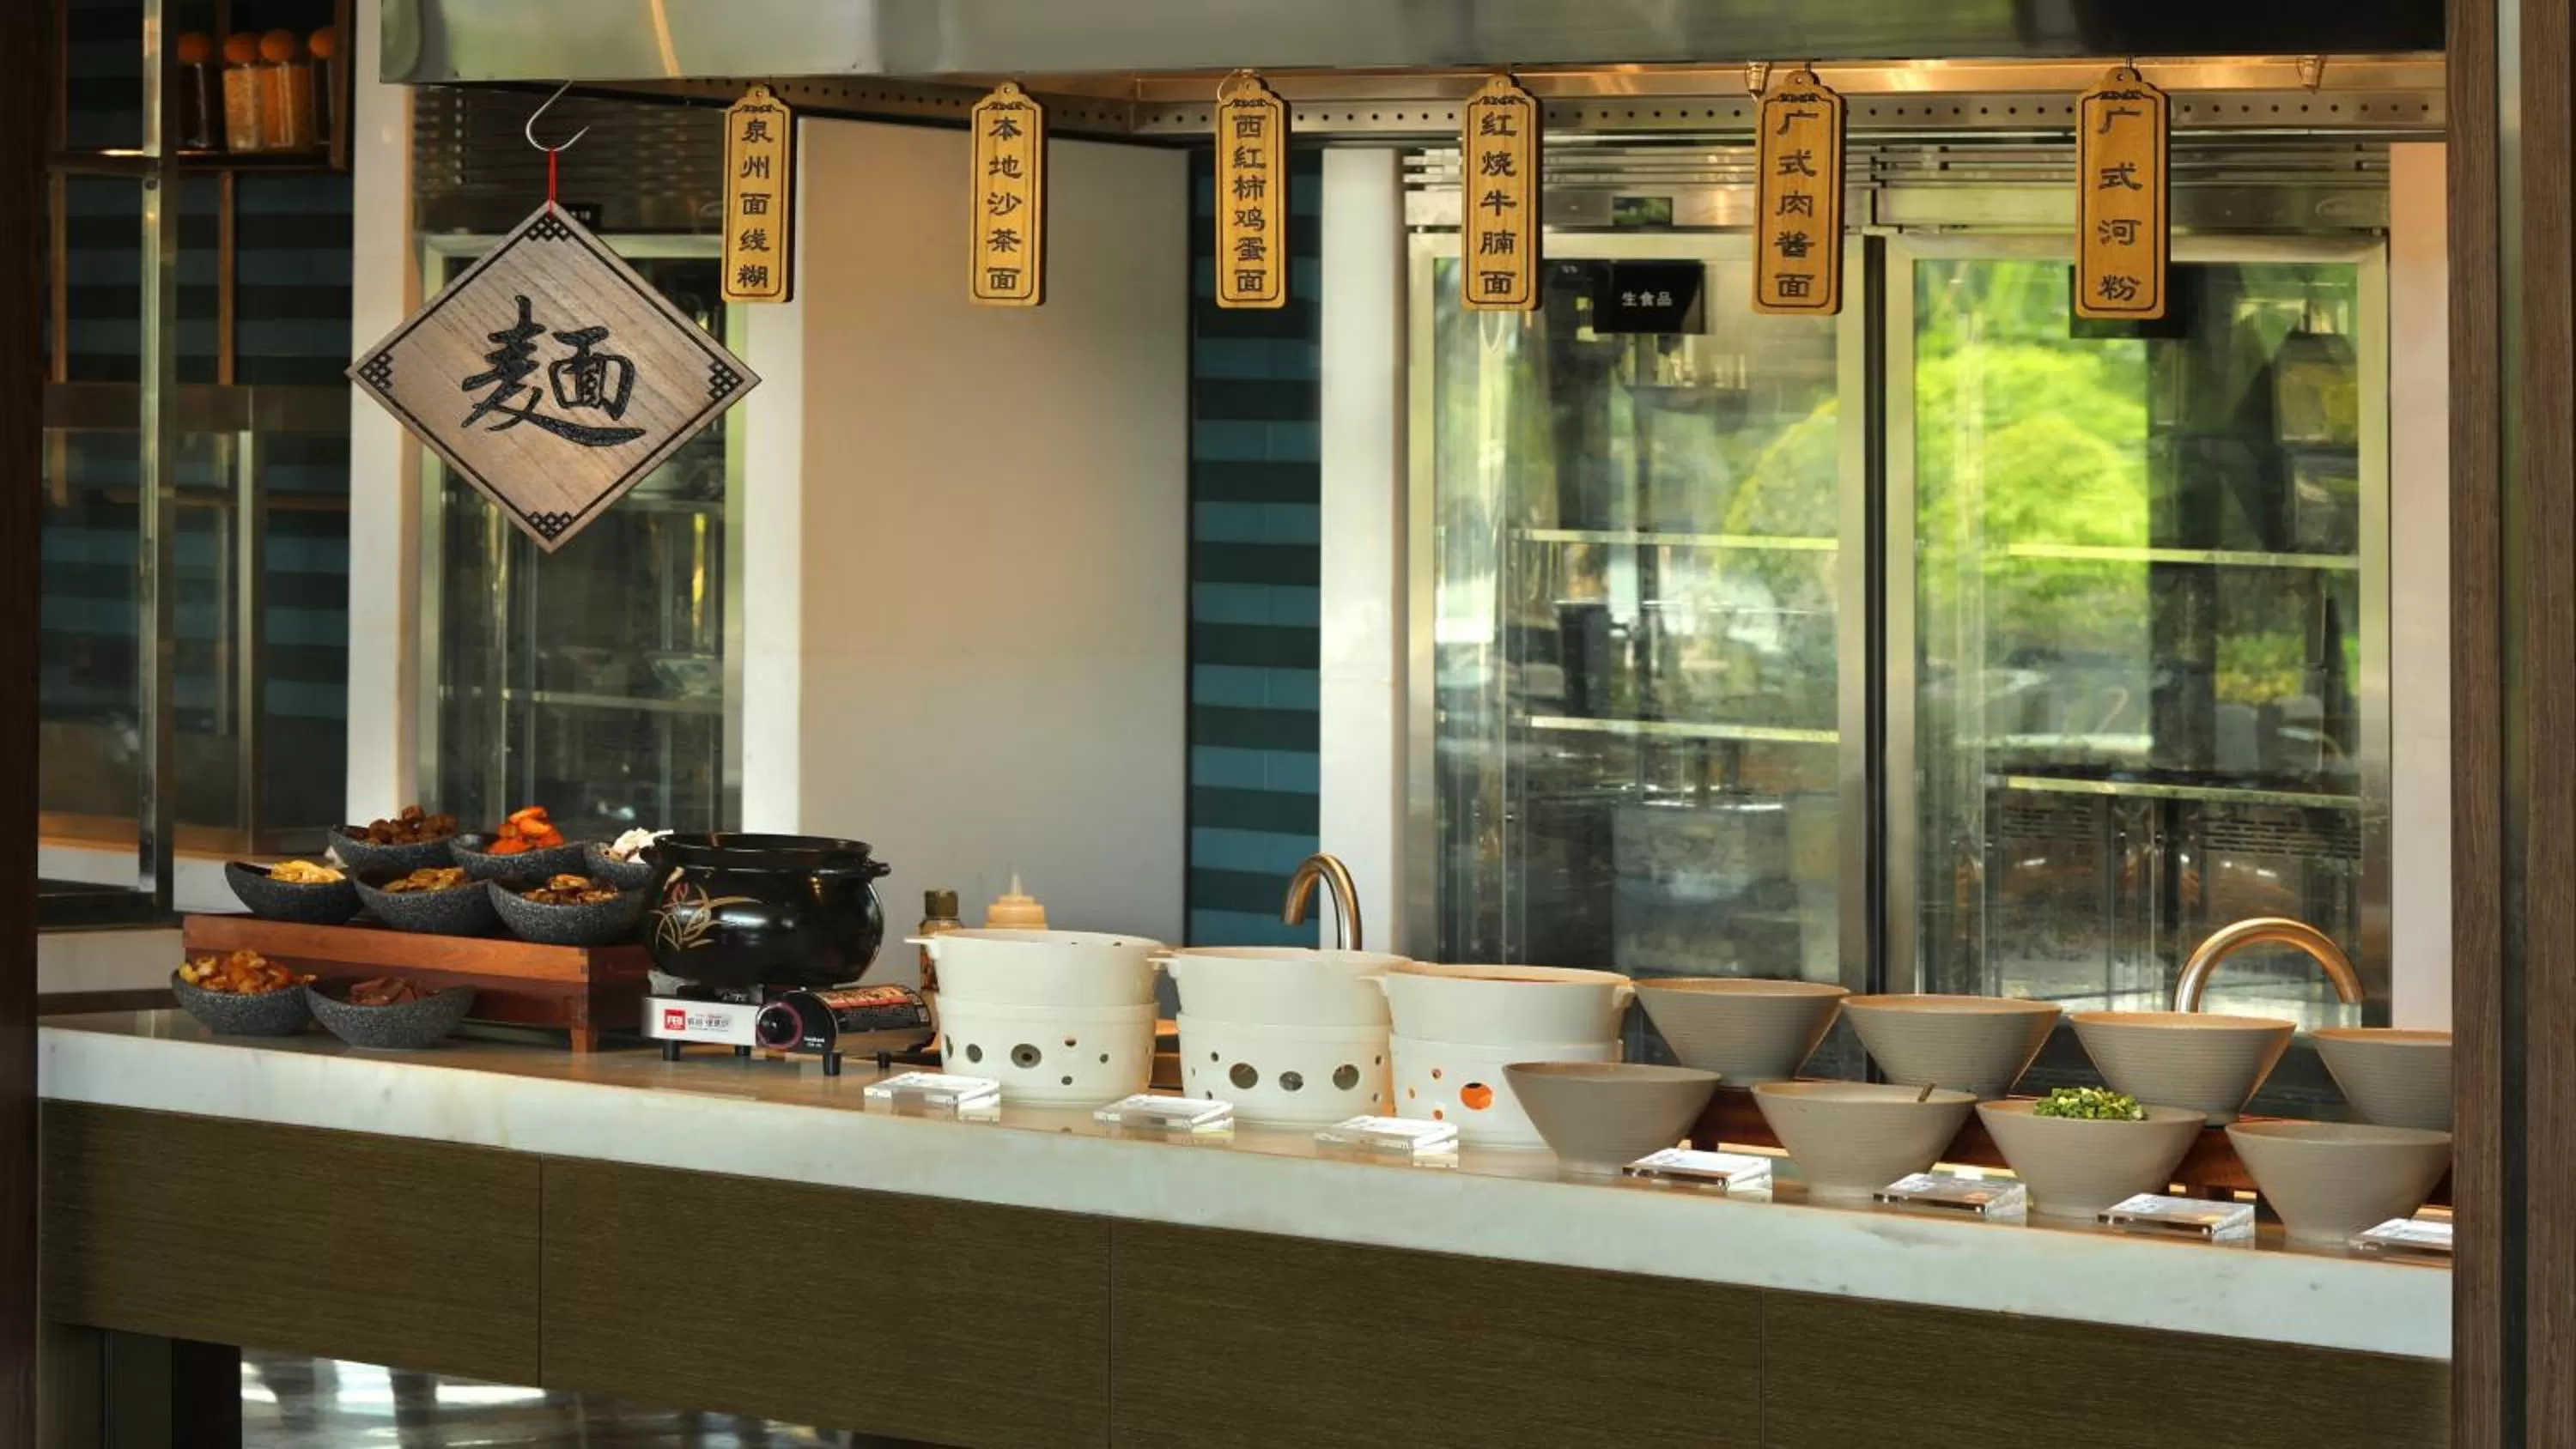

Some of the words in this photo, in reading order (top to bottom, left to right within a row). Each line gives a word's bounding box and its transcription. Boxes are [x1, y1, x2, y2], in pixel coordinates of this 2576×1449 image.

[738, 118, 772, 289] 泉州面线糊
[986, 108, 1024, 292] 本地沙茶面
[1479, 110, 1518, 294] 红烧牛腩面
[1773, 109, 1817, 298] 广式肉酱面
[2098, 108, 2143, 302] 广式河粉
[1622, 290, 1673, 307] 生食品
